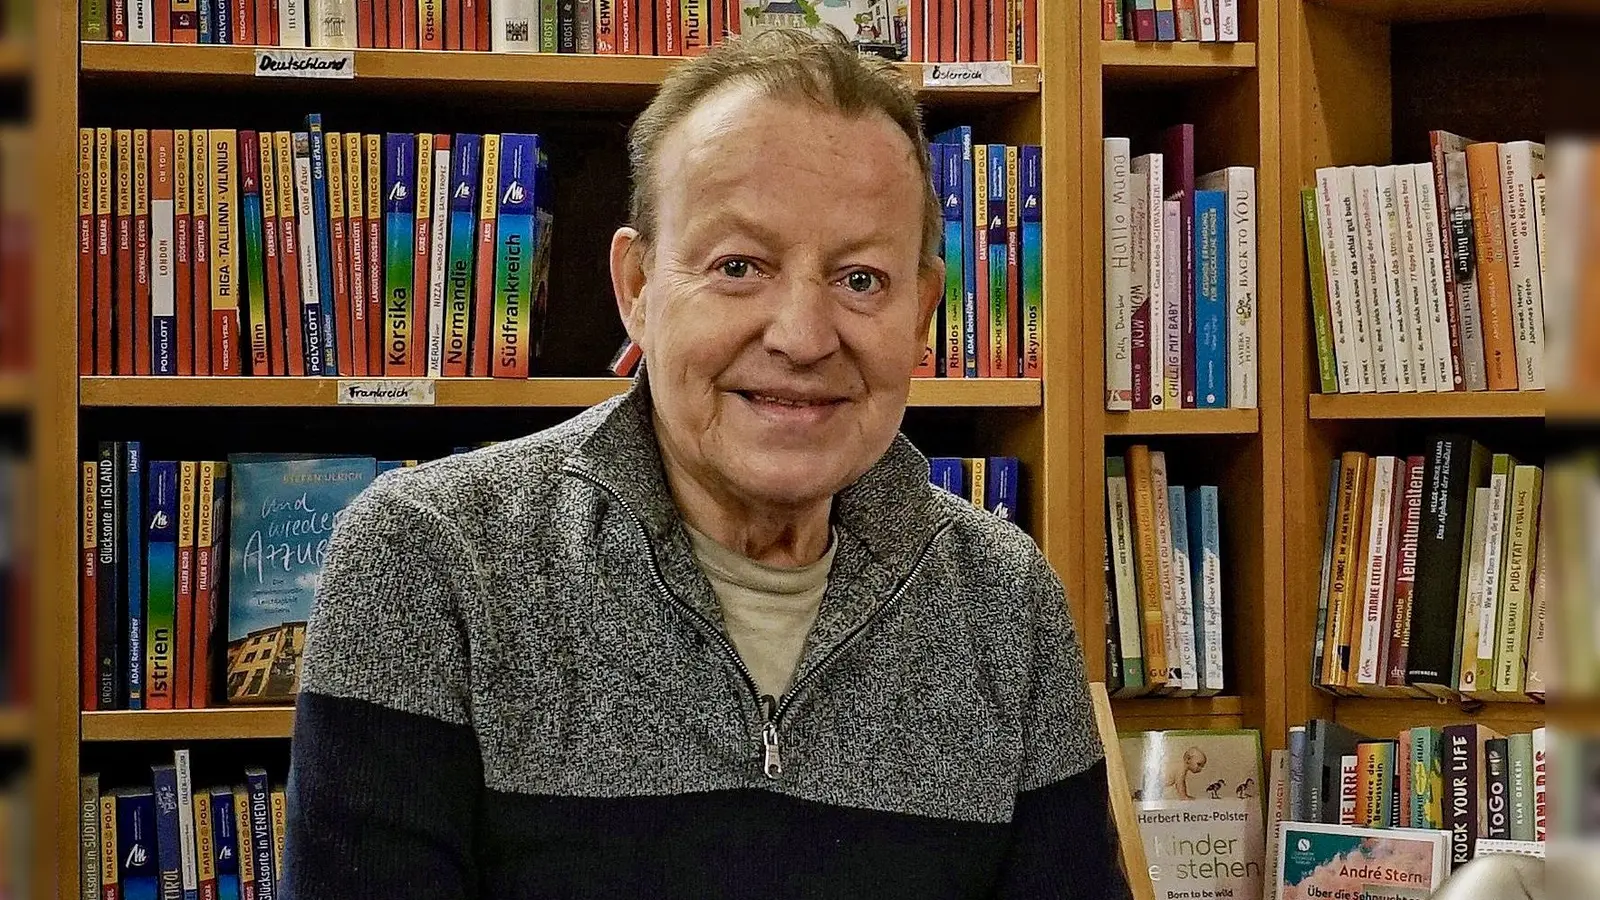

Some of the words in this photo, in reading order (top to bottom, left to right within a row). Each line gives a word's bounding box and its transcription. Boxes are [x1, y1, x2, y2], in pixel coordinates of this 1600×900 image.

[543, 17, 554, 48] DROSTE
[563, 17, 573, 48] DROSTE
[579, 20, 589, 50] DROSTE
[259, 54, 347, 71] Deutschland
[932, 65, 983, 80] Österreich
[82, 133, 90, 160] POLO
[120, 134, 128, 161] POLO
[159, 146, 167, 169] TOUR
[178, 134, 186, 161] POLO
[197, 134, 205, 161] POLO
[280, 136, 289, 163] POLO
[312, 135, 321, 160] d'Azur
[350, 137, 358, 164] POLO
[421, 138, 429, 165] POLO
[977, 149, 986, 175] POLO
[216, 141, 229, 193] VILNIUS
[1111, 154, 1127, 205] Mama
[1504, 154, 1517, 204] Intelligenz
[82, 173, 90, 210] MARCO
[178, 173, 186, 209] MARCO
[197, 173, 205, 210] MARCO
[282, 174, 291, 211] MARCO
[300, 194, 311, 216] Côte
[351, 176, 360, 212] MARCO
[420, 176, 428, 213] MARCO
[978, 185, 987, 221] MARCO
[1233, 188, 1250, 225] YOU
[1342, 196, 1353, 217] buch
[1516, 183, 1528, 219] Körpers
[1345, 218, 1356, 233] gut
[1455, 204, 1468, 235] Tanja
[1507, 206, 1517, 221] der
[217, 202, 231, 258] TALLINN
[1111, 214, 1128, 269] Hallo
[1238, 228, 1248, 247] TO
[1425, 221, 1437, 254] heilung
[1508, 222, 1518, 238] mit
[1518, 221, 1528, 238] des
[159, 240, 168, 276] LONDON
[1346, 235, 1357, 259] schlaf
[1510, 239, 1521, 269] Heilen
[218, 264, 231, 296] RIGA
[1238, 251, 1249, 288] BACK
[1349, 261, 1359, 276] das
[446, 259, 468, 364] Normandie
[500, 234, 522, 369] Südfrankreich
[1461, 281, 1474, 313] Brust
[1515, 284, 1526, 309] Henry
[387, 287, 407, 366] Korsika
[1167, 301, 1179, 330] BABY
[1464, 314, 1475, 340] raus
[1525, 307, 1537, 345] Johannes
[160, 319, 169, 372] POLYGLOTT
[252, 323, 266, 365] Tallinn
[308, 309, 321, 372] POLYGLOTT
[966, 334, 975, 355] ADAC
[1027, 305, 1039, 369] Zakynthos
[1130, 318, 1145, 349] WOW
[1168, 332, 1180, 352] MIT
[430, 334, 440, 370] MERIAN
[348, 385, 408, 398] Frankreich
[1168, 355, 1180, 398] CHILLIG
[1441, 441, 1453, 475] Kindheit
[86, 465, 94, 494] POLO
[100, 459, 113, 498] ISLAND
[182, 464, 191, 492] POLO
[1440, 475, 1449, 489] der
[101, 499, 112, 509] in
[1437, 489, 1449, 524] Alphabet
[86, 505, 94, 542] MARCO
[100, 512, 113, 564] Glücksorte
[182, 504, 190, 541] MARCO
[1396, 465, 1425, 583] Leuchtturmeltern
[1436, 523, 1445, 541] Das
[1177, 555, 1187, 585] Wasser
[1206, 554, 1216, 585] Wasser
[1369, 555, 1383, 586] ELTERN
[1178, 586, 1187, 607] über
[1207, 585, 1216, 606] über
[1366, 586, 1381, 622] STARKE
[1178, 606, 1189, 626] Kopf
[1206, 606, 1217, 626] Kopf
[1393, 597, 1405, 639] Melanie
[130, 663, 139, 684] ADAC
[149, 628, 169, 698] Istrien
[102, 672, 112, 703] DROSTE
[1452, 735, 1468, 771] LIFE
[1452, 776, 1468, 817] YOUR
[104, 802, 113, 829] POLO
[240, 800, 248, 828] POLO
[253, 792, 267, 839] VENEDIG
[1137, 813, 1181, 825] Herbert
[1183, 811, 1250, 825] Renz-Polster
[243, 839, 252, 876] MARCO
[257, 839, 268, 849] in
[1452, 823, 1469, 863] ROCK
[105, 841, 113, 878] MARCO
[1338, 863, 1382, 880] André
[1384, 868, 1424, 883] Stern
[1167, 890, 1188, 900] Born
[1191, 891, 1201, 900] to
[1202, 889, 1213, 900] be
[1213, 888, 1235, 899] wild
[1306, 884, 1333, 898] Über
[1333, 888, 1351, 900] die
